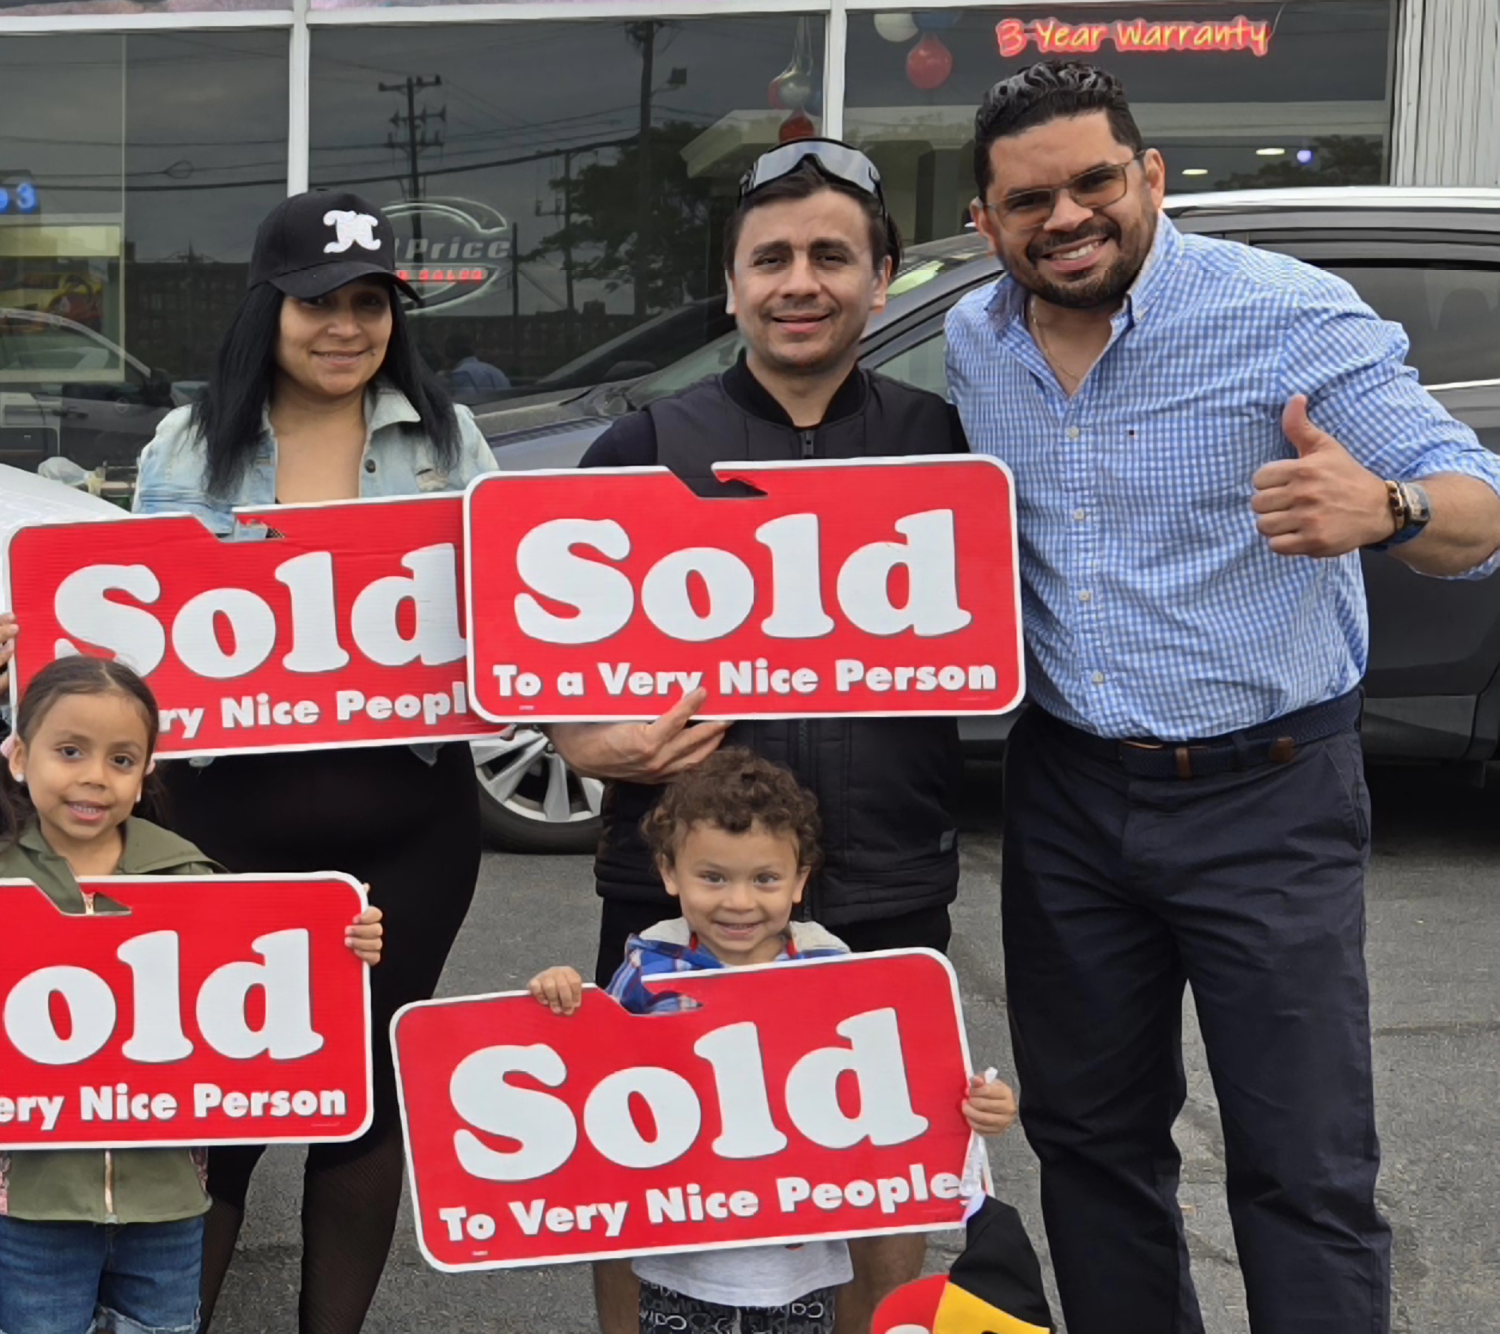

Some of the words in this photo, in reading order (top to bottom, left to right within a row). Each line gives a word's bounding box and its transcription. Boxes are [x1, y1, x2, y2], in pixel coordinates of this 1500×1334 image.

[1113, 15, 1271, 56] Warranty
[15, 182, 36, 212] 3
[514, 509, 972, 645] Sold
[54, 542, 462, 679] Sold
[493, 664, 541, 697] To
[556, 672, 585, 697] a
[598, 662, 703, 699] Very
[719, 659, 819, 696] Nice
[835, 660, 997, 693] Person
[157, 707, 205, 739] ry
[220, 693, 320, 728] Nice
[336, 681, 467, 725] Peopl
[80, 1083, 178, 1121] Nice
[193, 1083, 347, 1118] Person
[449, 1007, 929, 1181] Sold
[440, 1207, 496, 1241] To
[509, 1199, 629, 1237] Very
[645, 1182, 760, 1224] Nice
[777, 1163, 962, 1214] People
